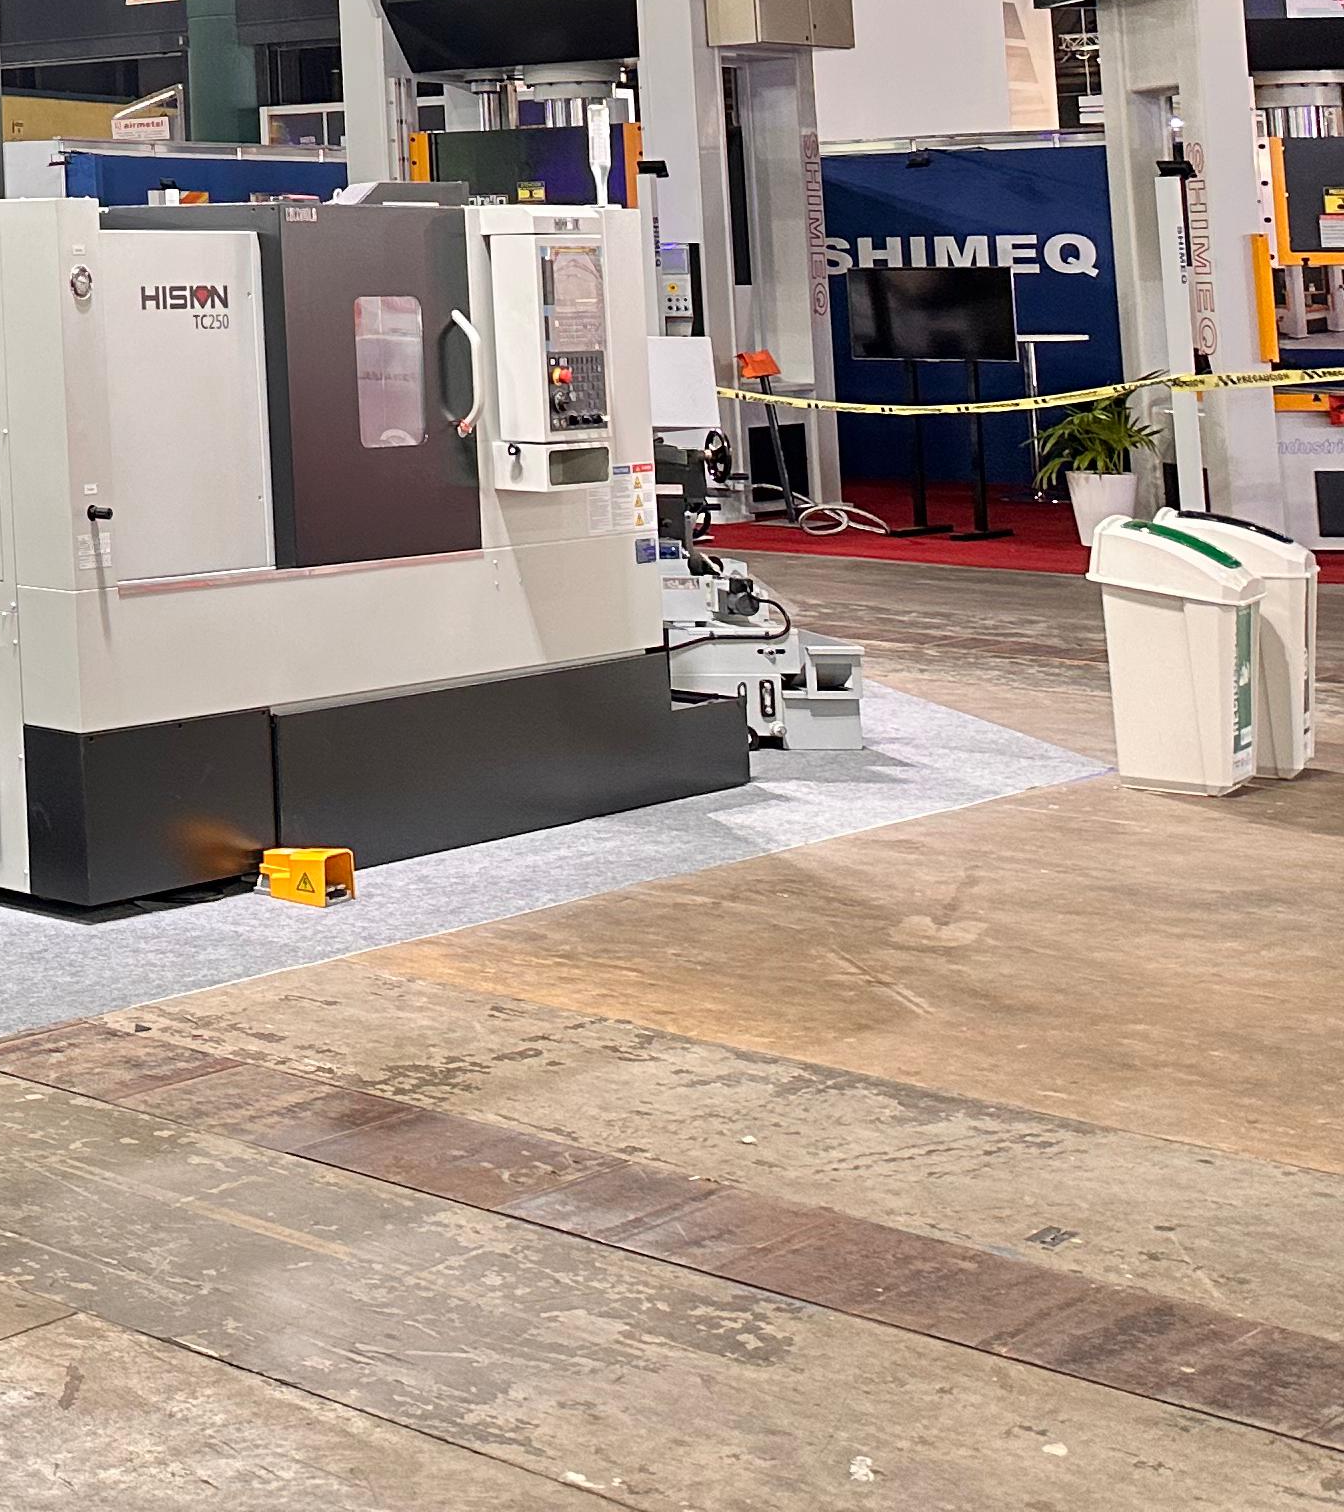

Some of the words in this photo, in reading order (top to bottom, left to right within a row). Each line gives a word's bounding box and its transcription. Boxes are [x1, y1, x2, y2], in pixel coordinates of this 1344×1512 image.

[802, 132, 828, 317] SHIMEQ
[824, 233, 1100, 278] SHIMEQ
[193, 314, 229, 329] TC250
